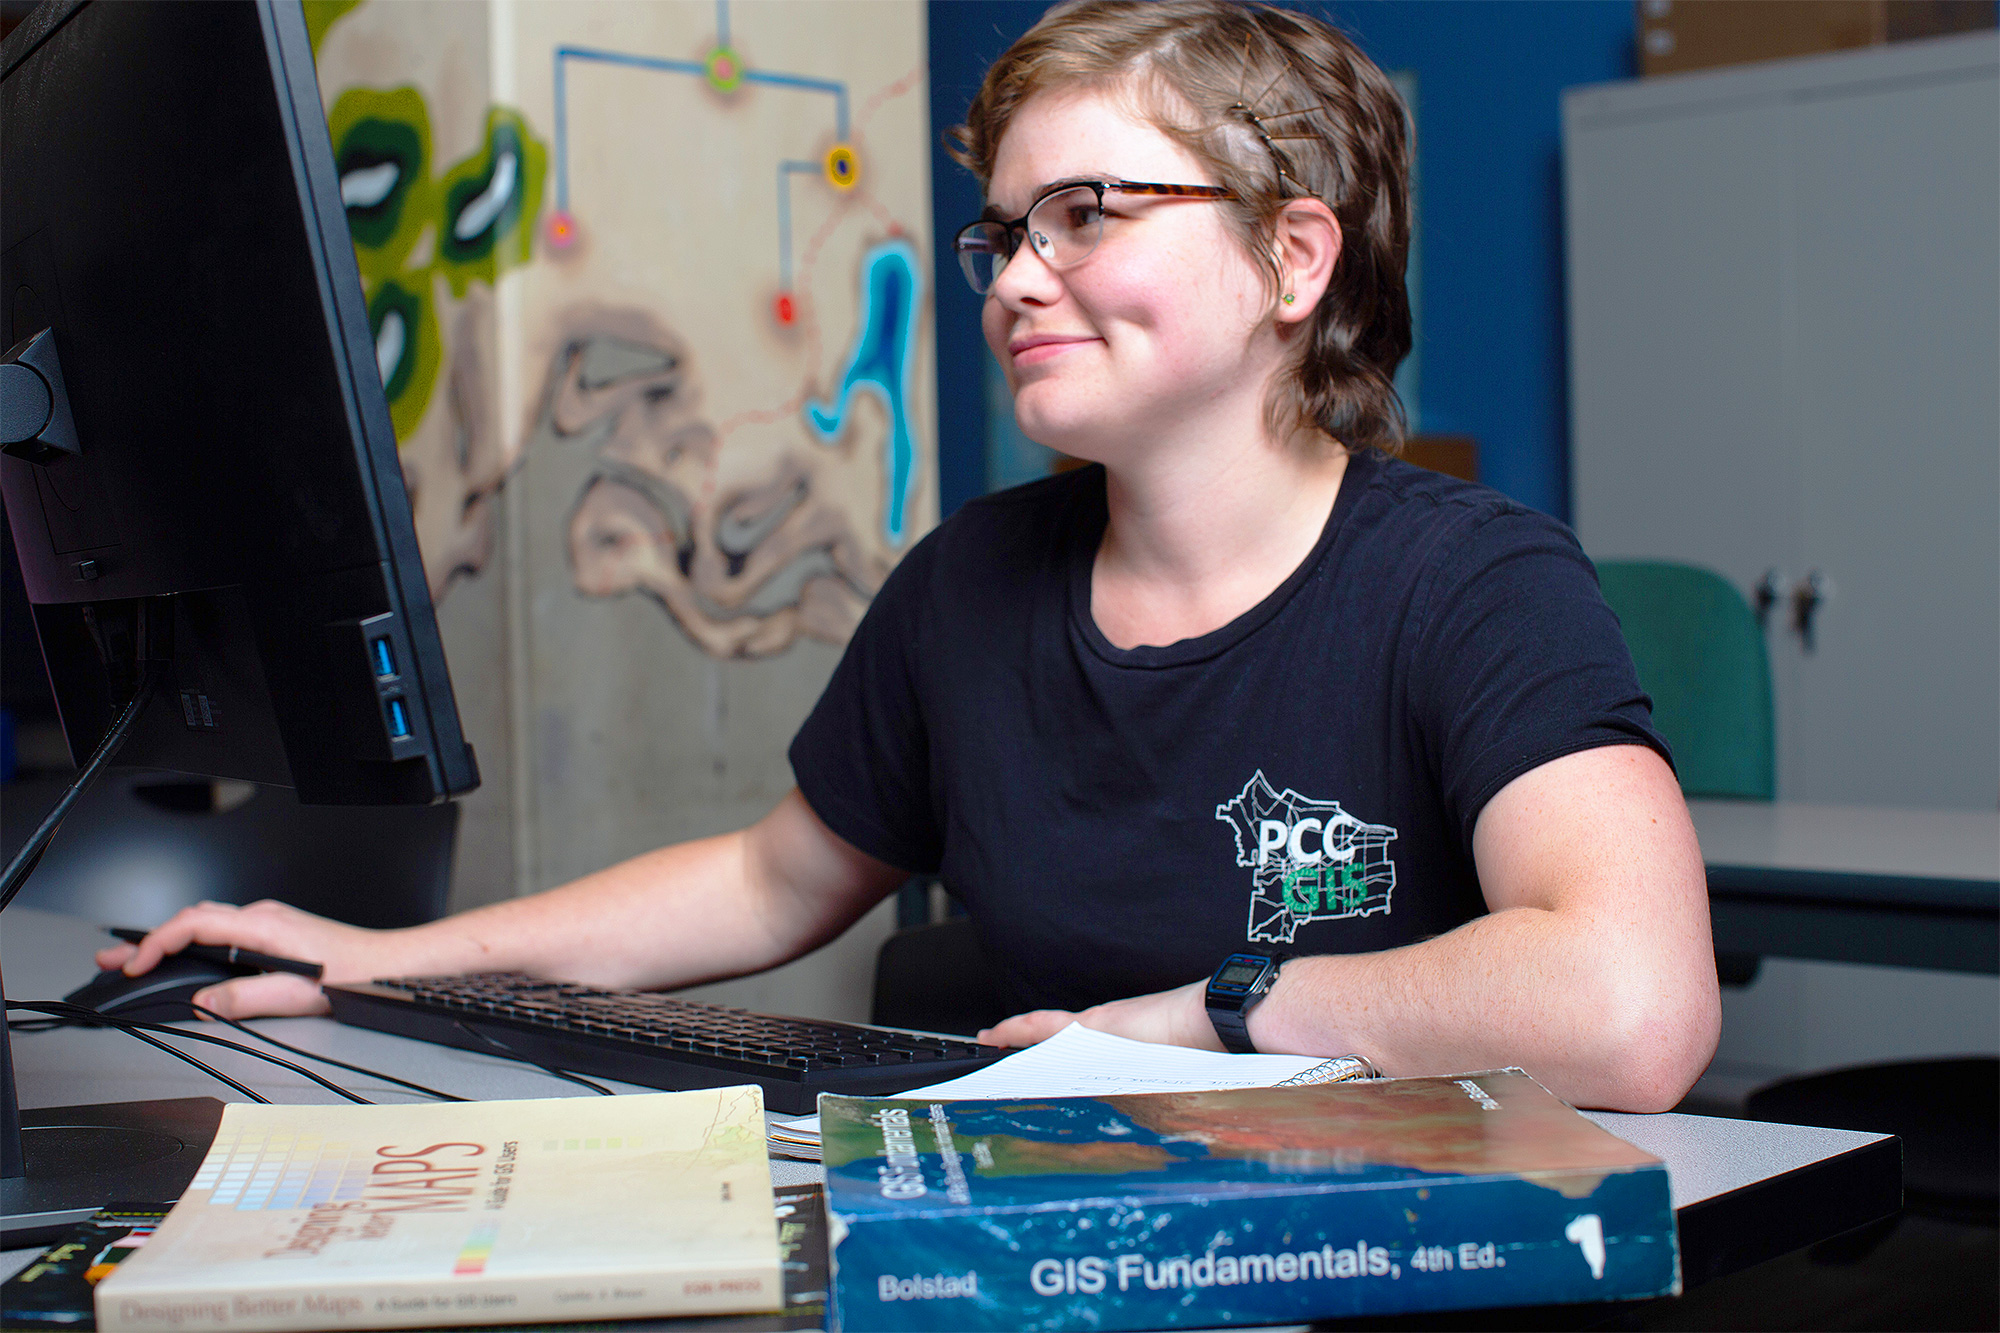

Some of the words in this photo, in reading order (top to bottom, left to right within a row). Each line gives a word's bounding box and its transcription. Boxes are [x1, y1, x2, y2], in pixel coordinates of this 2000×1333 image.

[1257, 813, 1357, 866] PCC
[1281, 861, 1369, 913] GIS
[494, 1163, 515, 1175] GIS
[497, 1140, 519, 1163] Users
[358, 1141, 485, 1215] MAPS
[878, 1269, 978, 1301] Bolstad
[1030, 1256, 1106, 1296] GIS
[1116, 1239, 1401, 1291] Fundamentals,
[1410, 1245, 1453, 1273] 4th
[1458, 1241, 1506, 1270] Ed.
[119, 1297, 230, 1323] Designing
[231, 1294, 297, 1318] Better
